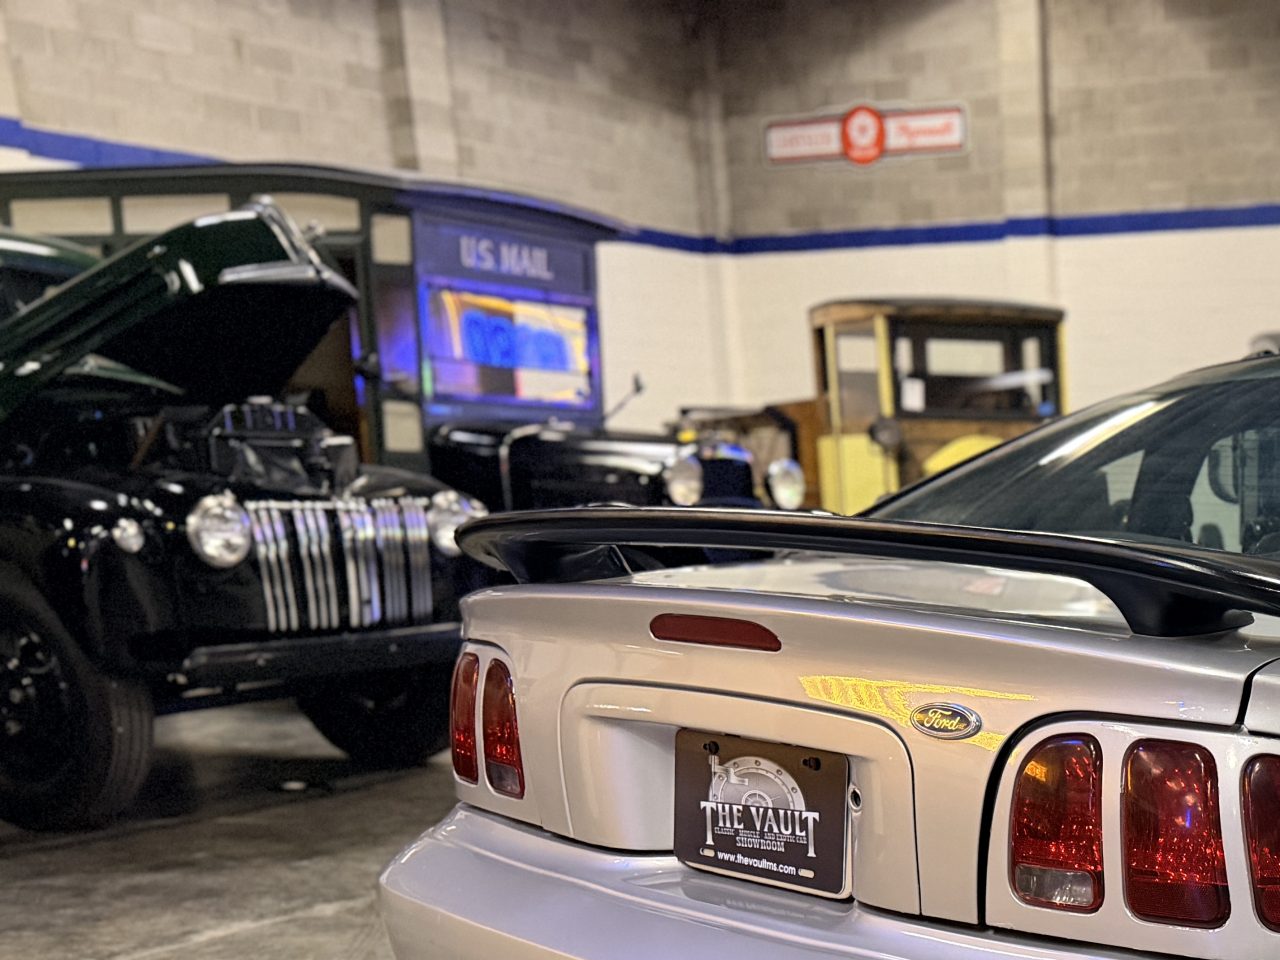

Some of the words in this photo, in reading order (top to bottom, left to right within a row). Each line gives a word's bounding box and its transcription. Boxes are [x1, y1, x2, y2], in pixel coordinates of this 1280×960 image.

[923, 708, 961, 730] Ford
[700, 801, 744, 846] THE
[749, 806, 820, 858] VAULT
[714, 826, 735, 836] CLASSIC
[738, 829, 761, 839] MUSCLE
[764, 832, 776, 841] AND
[776, 833, 796, 843] EXOTIC
[796, 836, 808, 844] CAR
[736, 836, 785, 853] SHOWROOM
